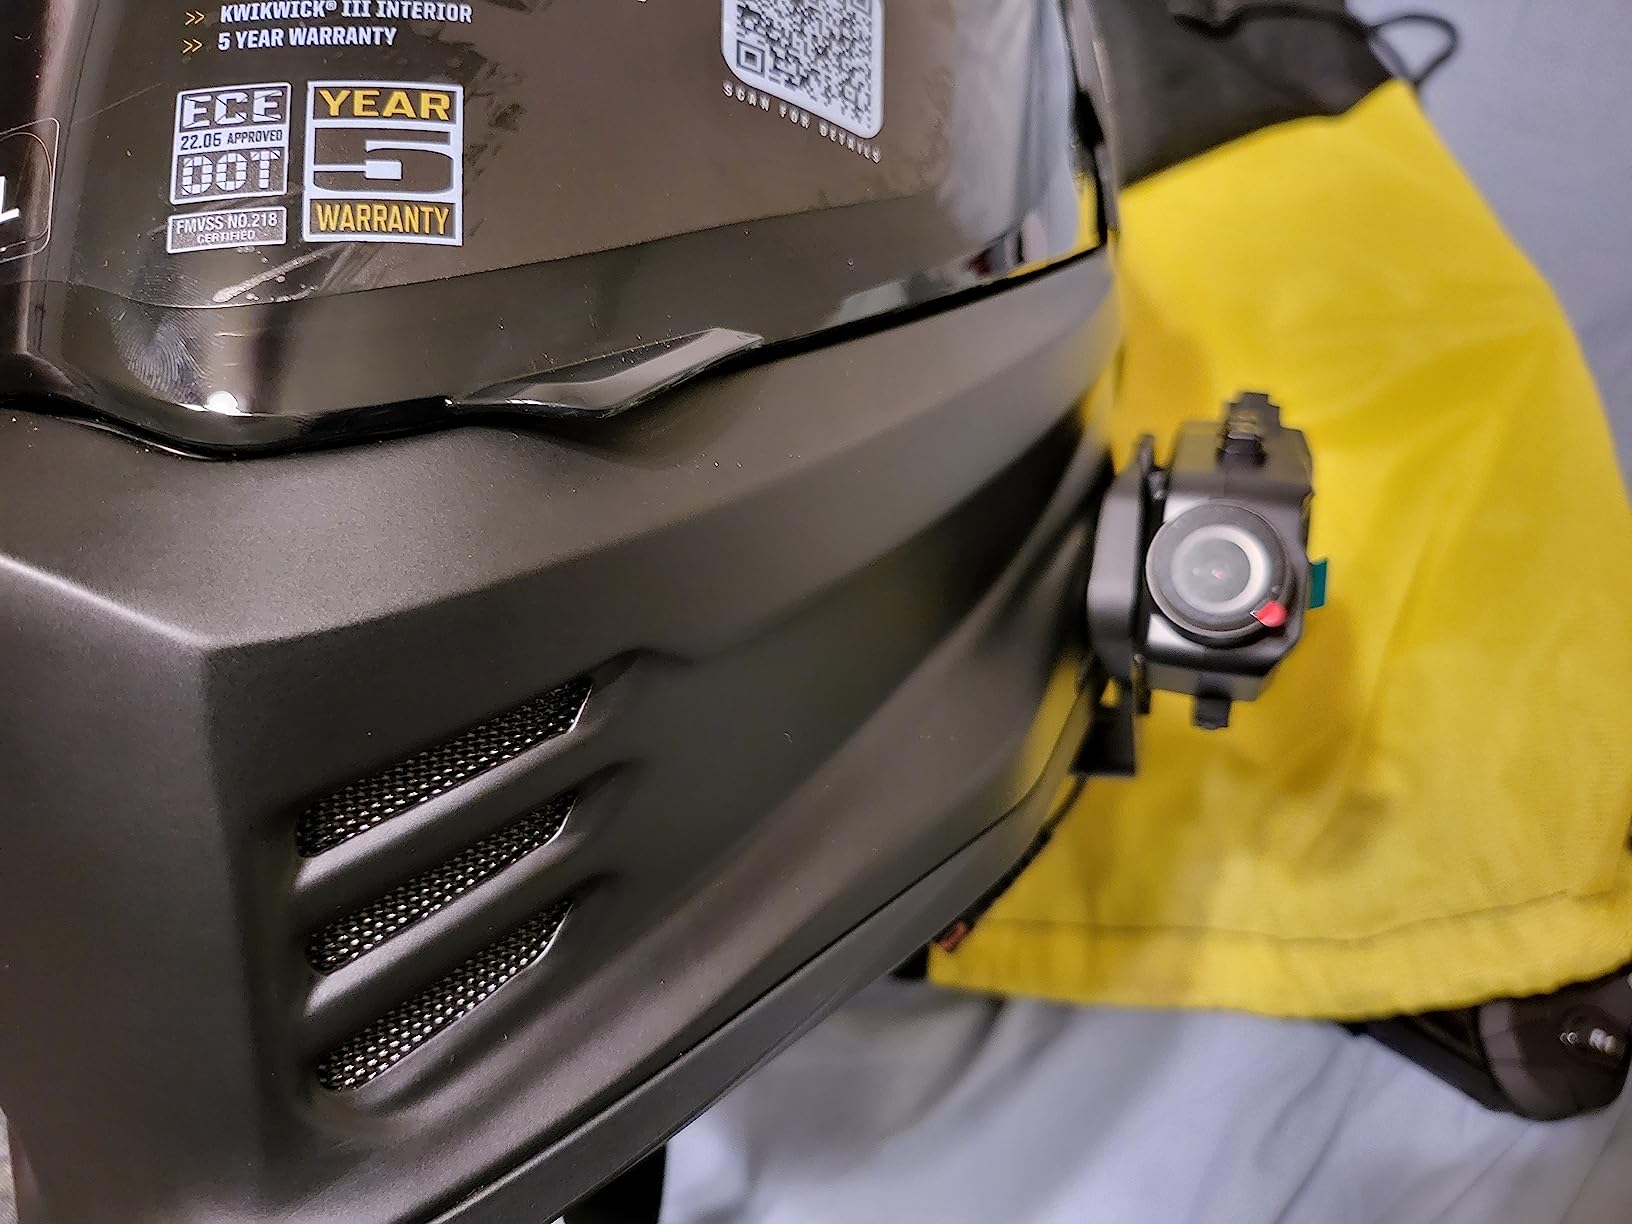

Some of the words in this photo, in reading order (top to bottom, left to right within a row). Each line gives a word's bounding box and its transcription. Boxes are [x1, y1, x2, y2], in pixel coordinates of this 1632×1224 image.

[341, 0, 371, 18] III
[375, 0, 473, 23] INTERIOR
[217, 31, 231, 51] 5
[235, 28, 284, 49] YEAR
[287, 26, 397, 47] WARRANTY
[182, 89, 284, 129] ECE
[319, 88, 450, 121] YEAR
[778, 102, 810, 129] FOR
[226, 129, 283, 144] APPROVED
[181, 150, 281, 196] DOT
[313, 127, 454, 194] 5
[176, 215, 225, 235] FMVSS
[227, 212, 278, 230] NO.218
[315, 202, 450, 235] WARRANTY
[196, 229, 256, 245] CERTIFIED
